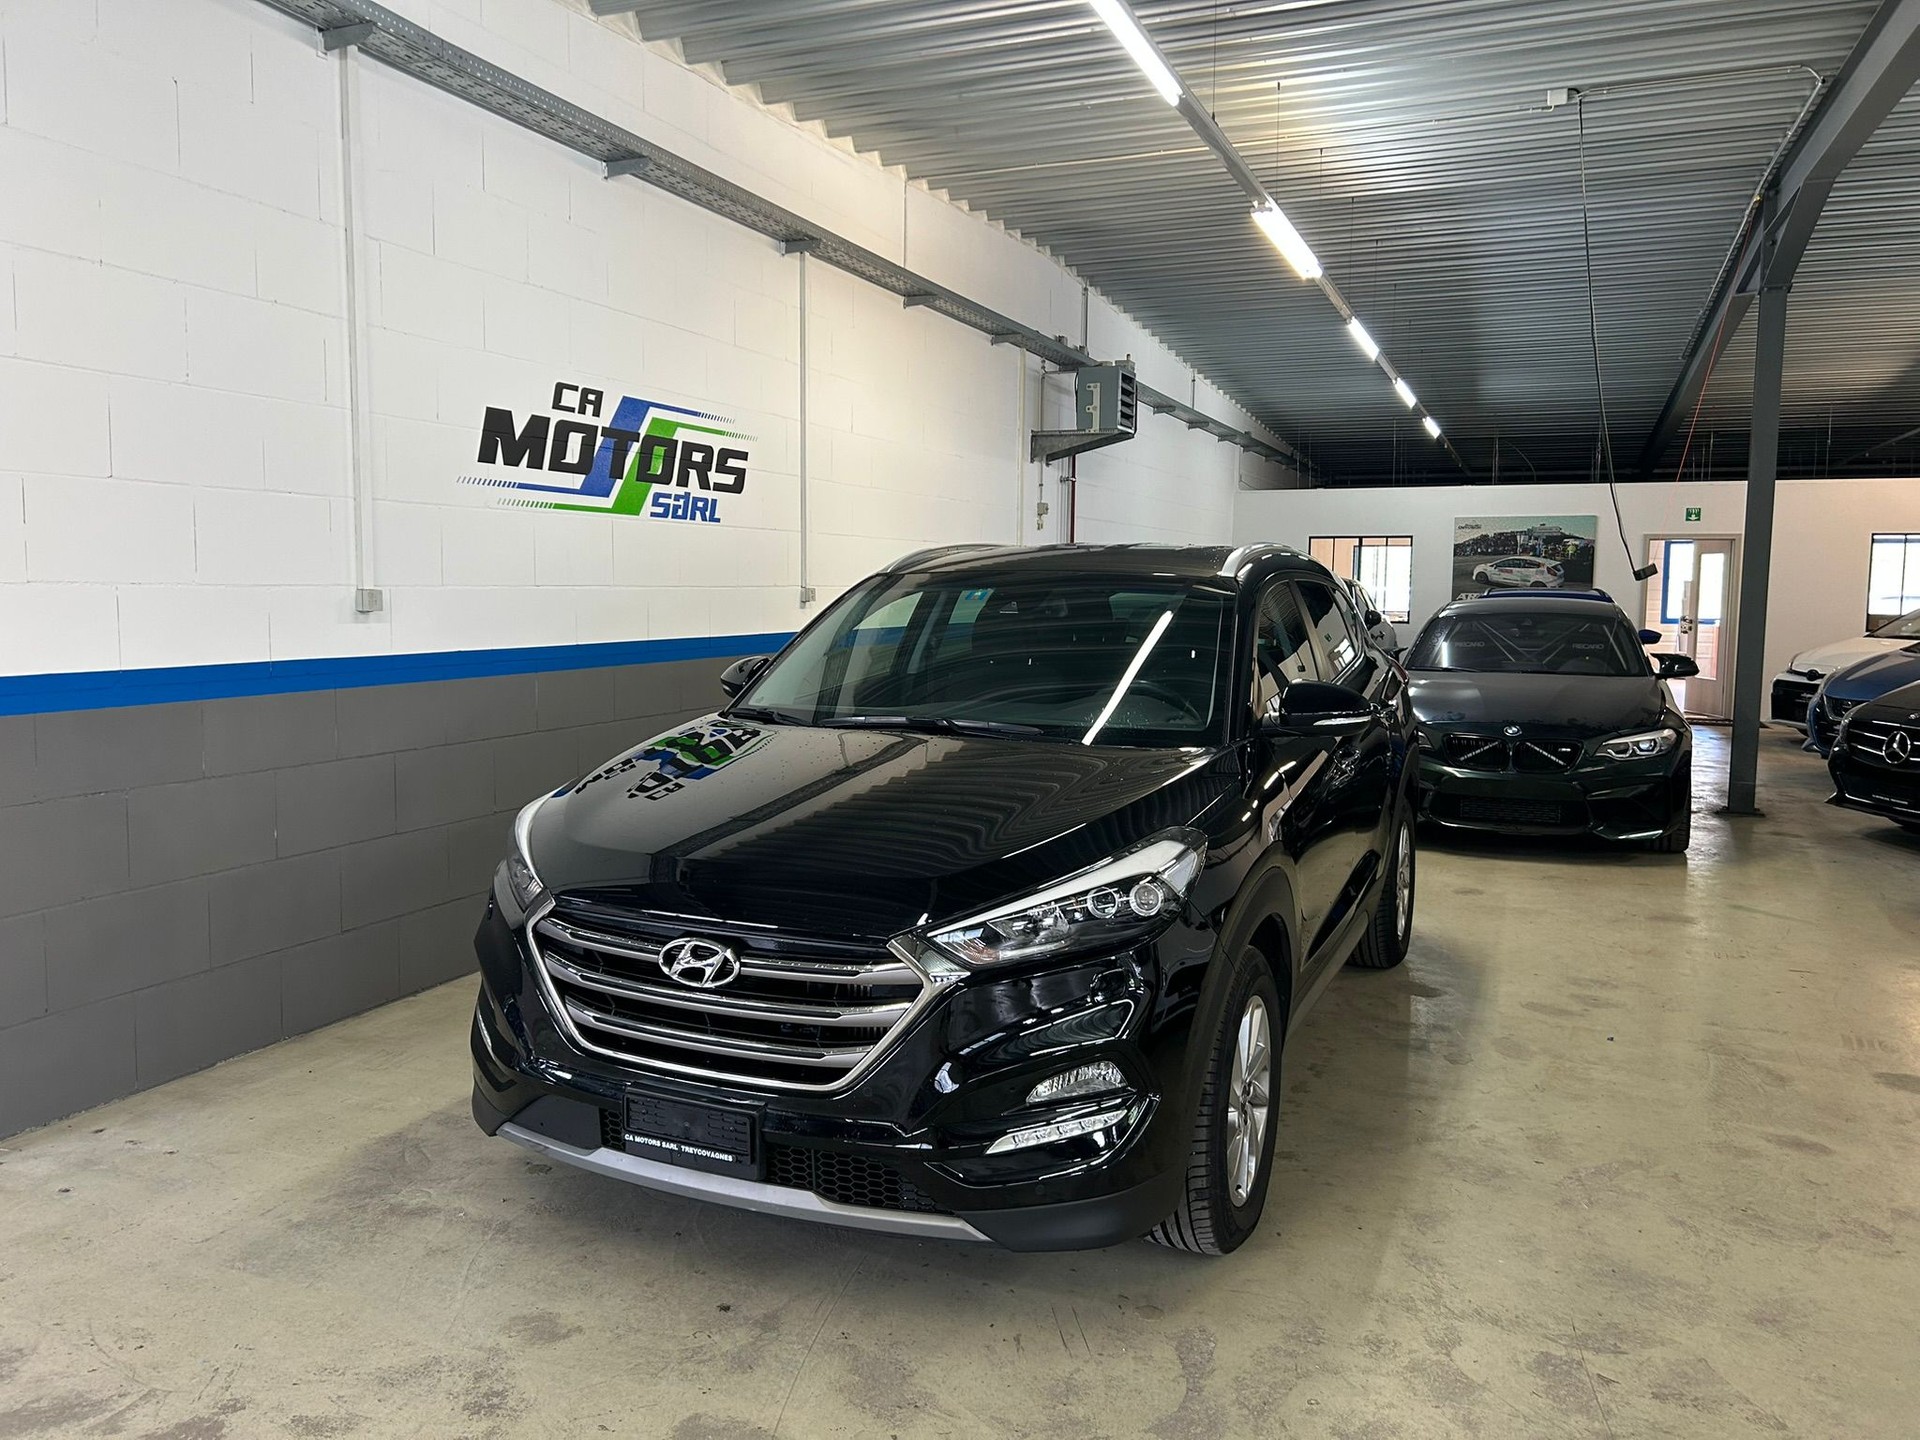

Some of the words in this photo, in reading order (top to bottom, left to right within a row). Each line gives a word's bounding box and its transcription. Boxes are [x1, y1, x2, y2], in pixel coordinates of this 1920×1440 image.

[551, 381, 604, 418] CA
[477, 406, 749, 494] MOTORS
[624, 1133, 634, 1142] CA
[634, 1135, 661, 1147] MOTORS
[661, 1141, 679, 1151] SARL
[680, 1145, 734, 1163] TREYCOVAGNES
